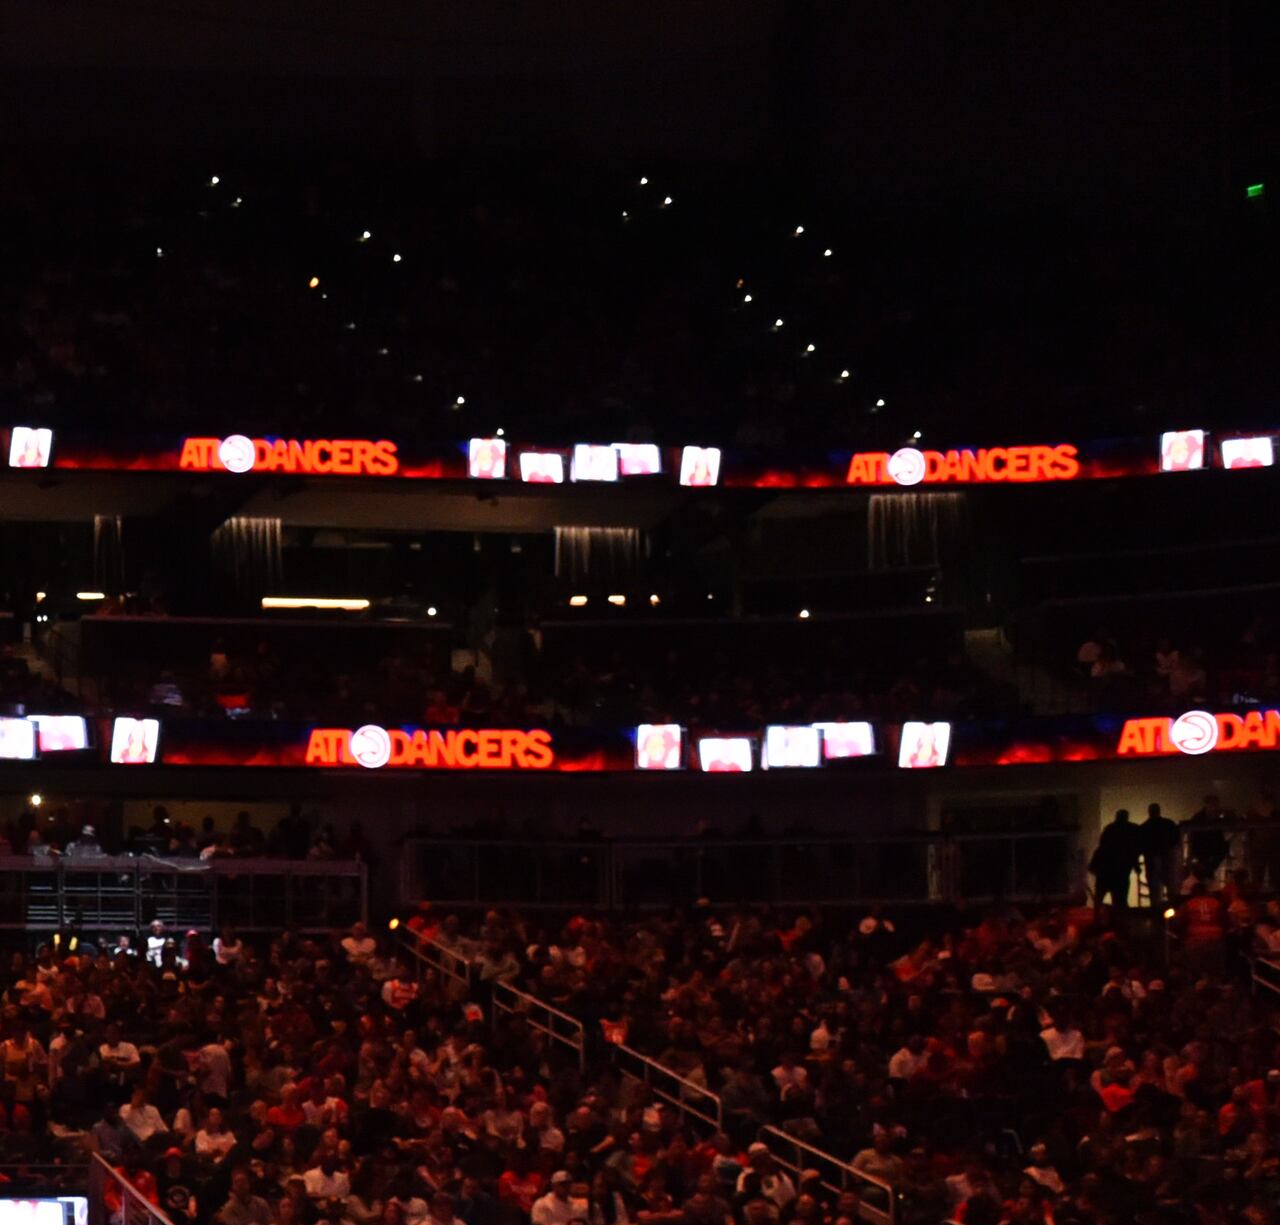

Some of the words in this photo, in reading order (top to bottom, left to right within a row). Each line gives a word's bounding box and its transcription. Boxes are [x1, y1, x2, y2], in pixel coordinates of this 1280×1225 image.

[253, 439, 398, 475] DANCERS
[924, 446, 1080, 482] DANCERS
[389, 730, 554, 768] DANCERS
